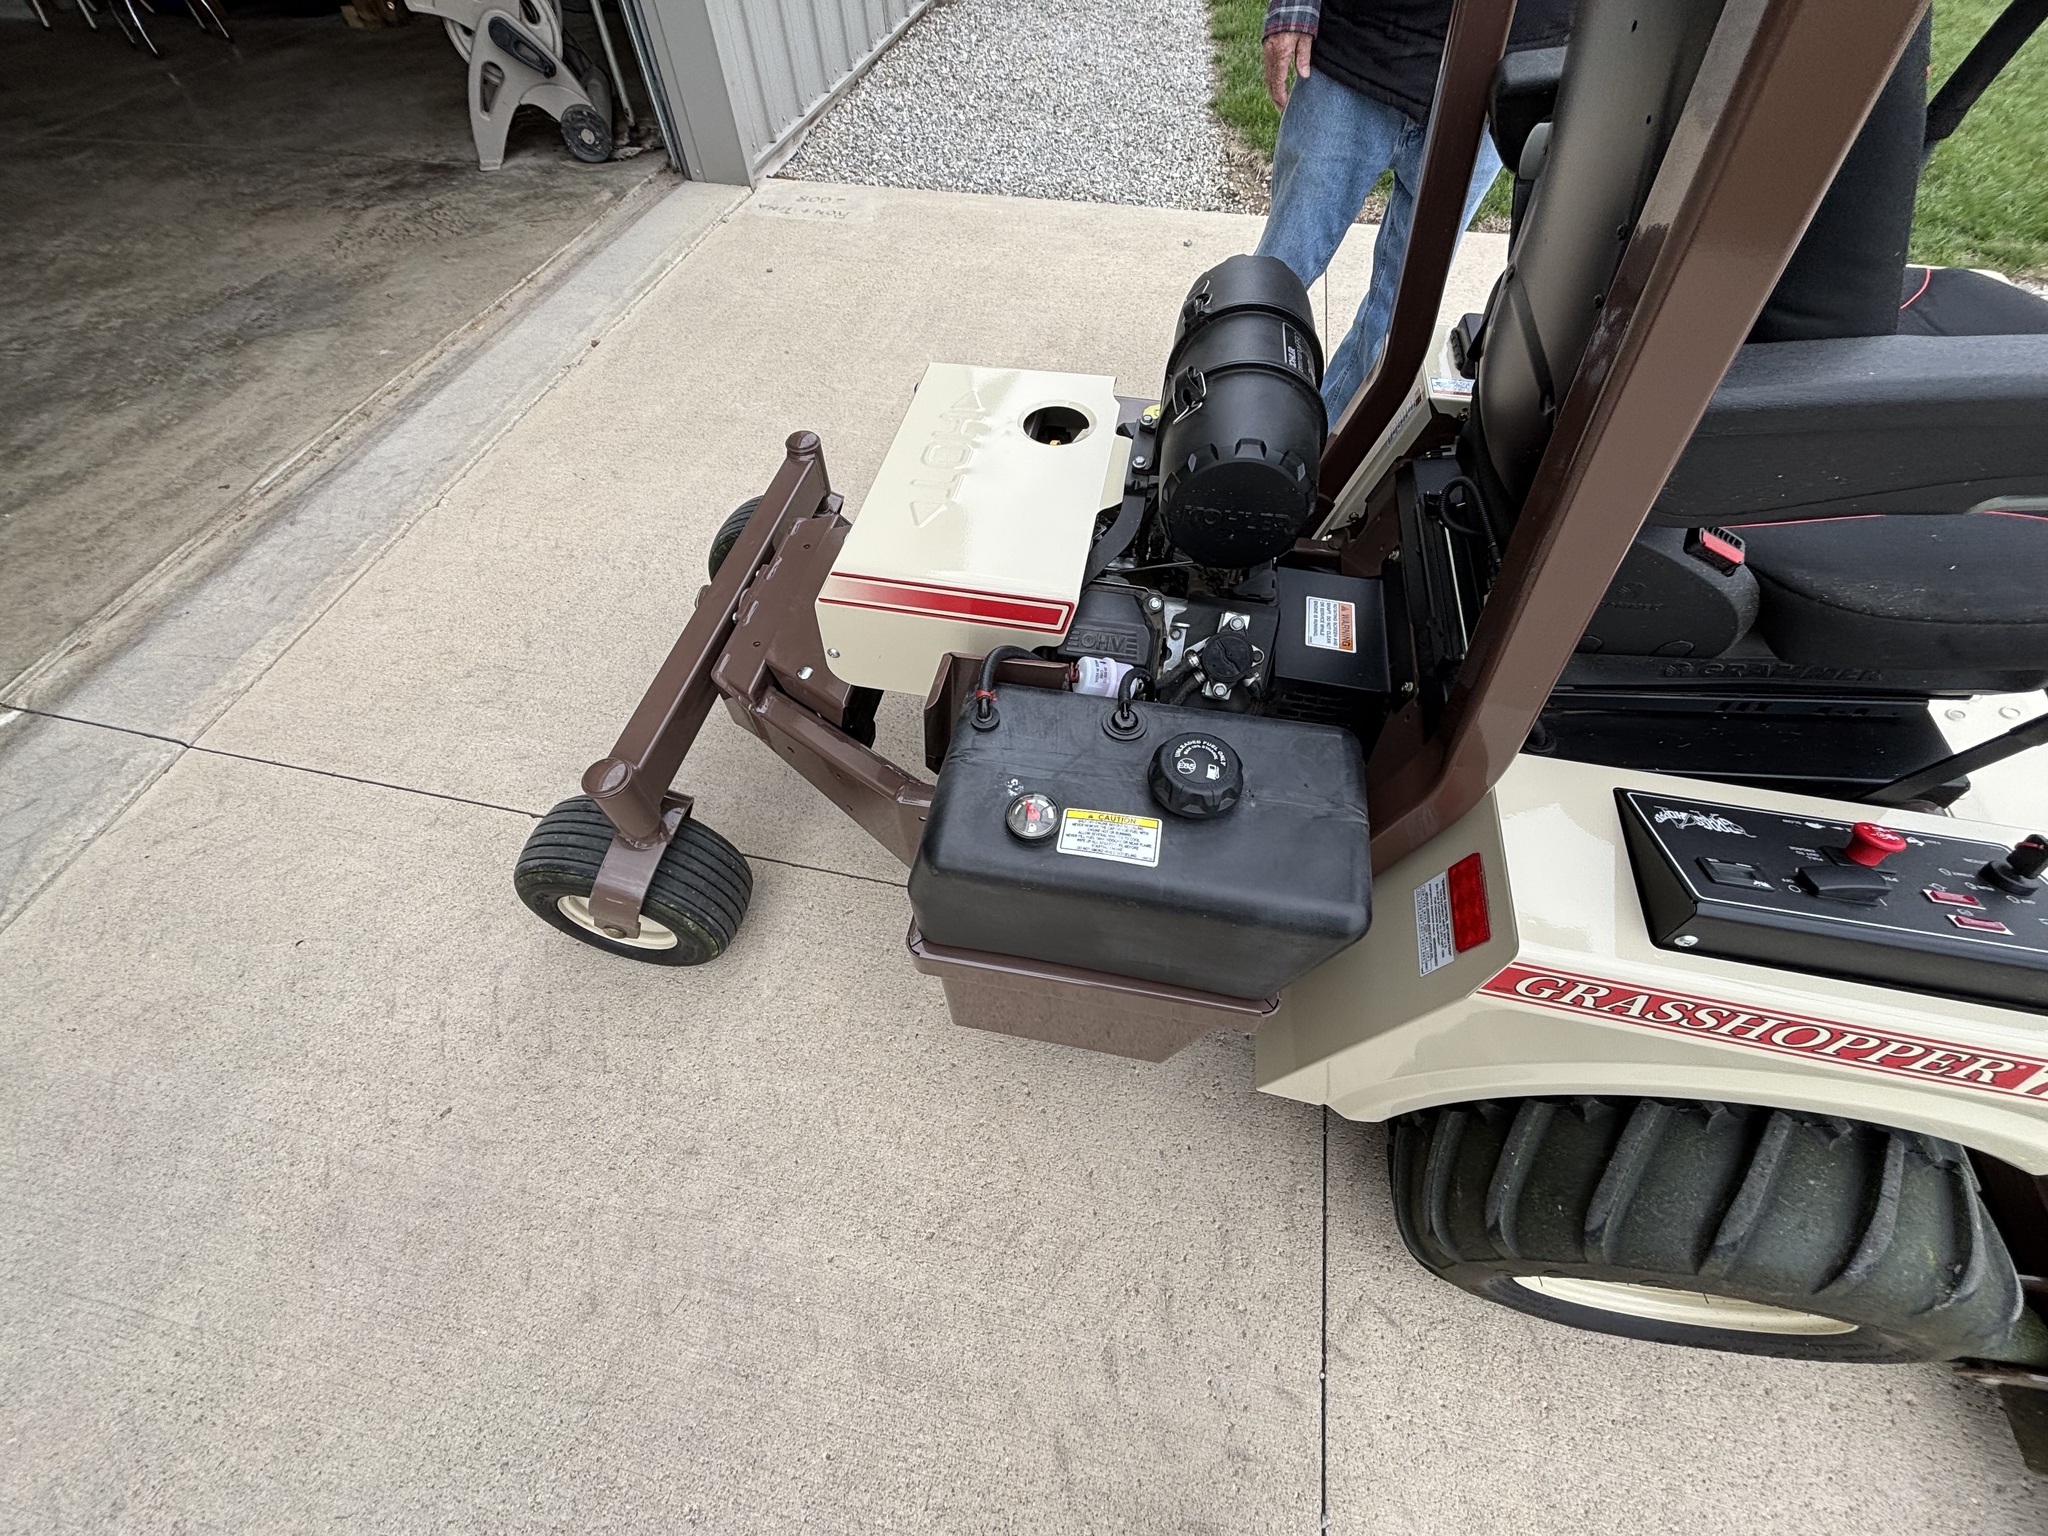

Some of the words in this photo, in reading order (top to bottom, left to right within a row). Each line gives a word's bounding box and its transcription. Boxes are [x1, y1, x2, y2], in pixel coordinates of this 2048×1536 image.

[1081, 631, 1127, 653] OHV
[1341, 613, 1351, 647] WARNING
[1174, 740, 1202, 758] UNLEADED
[1202, 740, 1218, 751] FUEL
[1217, 750, 1226, 766] ONLY
[1098, 814, 1136, 825] CAUTION
[1514, 975, 2018, 1084] GRASSHOPPER
